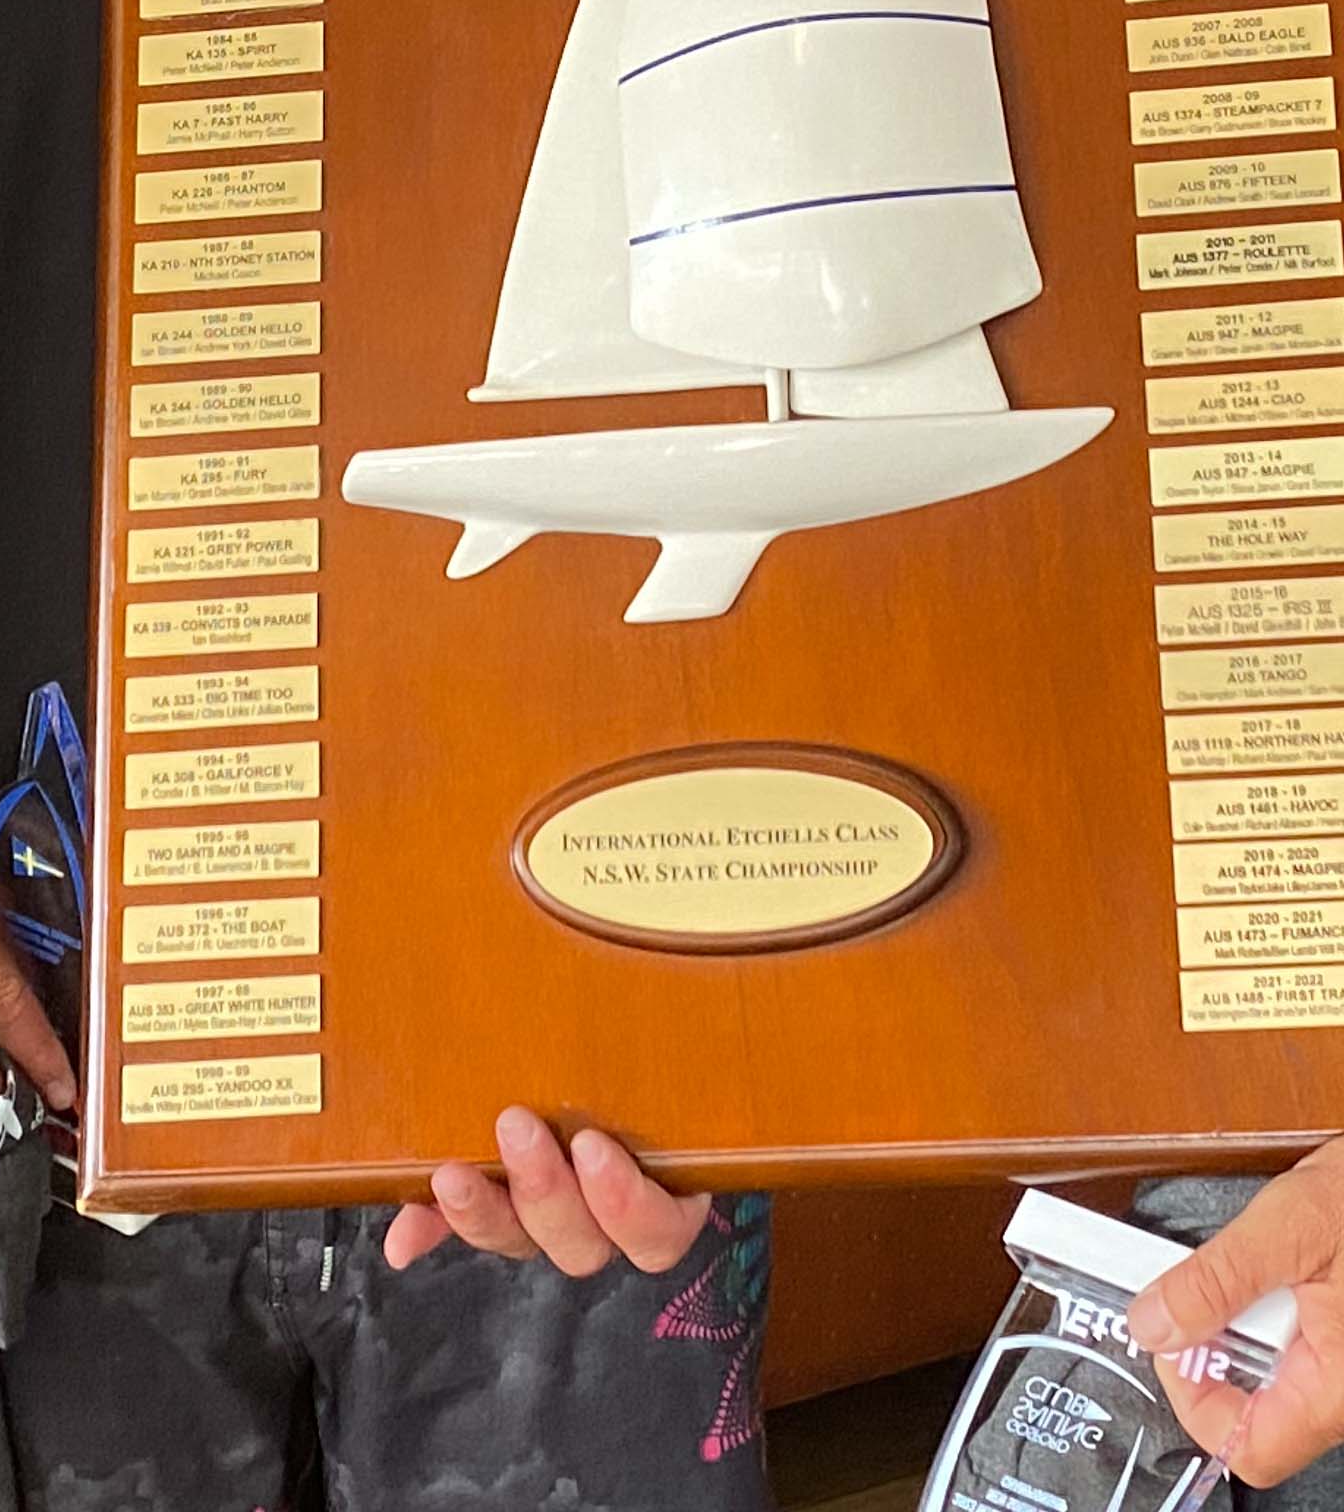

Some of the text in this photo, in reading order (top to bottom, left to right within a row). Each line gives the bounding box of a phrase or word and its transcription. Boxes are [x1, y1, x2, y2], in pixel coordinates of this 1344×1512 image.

[1217, 26, 1305, 45] BALD EAGLE
[236, 42, 276, 57] SPIRIT
[1212, 99, 1311, 118] STEAMPACKET
[210, 110, 288, 128] FAST HARRY
[223, 180, 286, 196] PHANTOM
[1241, 172, 1297, 188] FIFTEEN
[1205, 232, 1275, 249] 2010 2011
[215, 252, 263, 267] SYDNEY
[265, 248, 315, 263] STATION
[1172, 252, 1199, 265] AUS
[1242, 243, 1310, 260] ROULETTE
[202, 320, 303, 339] GOLDEN HELLO
[1250, 323, 1303, 338] MAGPIE
[202, 392, 301, 411] GOLDEN HELLO
[233, 467, 267, 481] FURY
[1192, 462, 1314, 481] AUS MAGPIE
[205, 538, 293, 556] GREY POWER
[1208, 530, 1308, 547] THE HOLE WAY
[263, 612, 311, 626] PARADE
[1258, 668, 1307, 682] TANGO
[265, 687, 293, 700] TOO
[1243, 733, 1321, 748] NORTHERN
[562, 823, 899, 852] INTERNATIONAL ETCHELLS CLASS
[583, 859, 879, 886] N.S.W. STATE CHAMPIONSHIP
[1217, 866, 1247, 879] AUS
[221, 919, 286, 934] THE BOAT
[1275, 989, 1315, 1002] FIRST
[184, 995, 316, 1014] GREAT WHITE HUNTER
[215, 1079, 272, 1093] YANDOO
